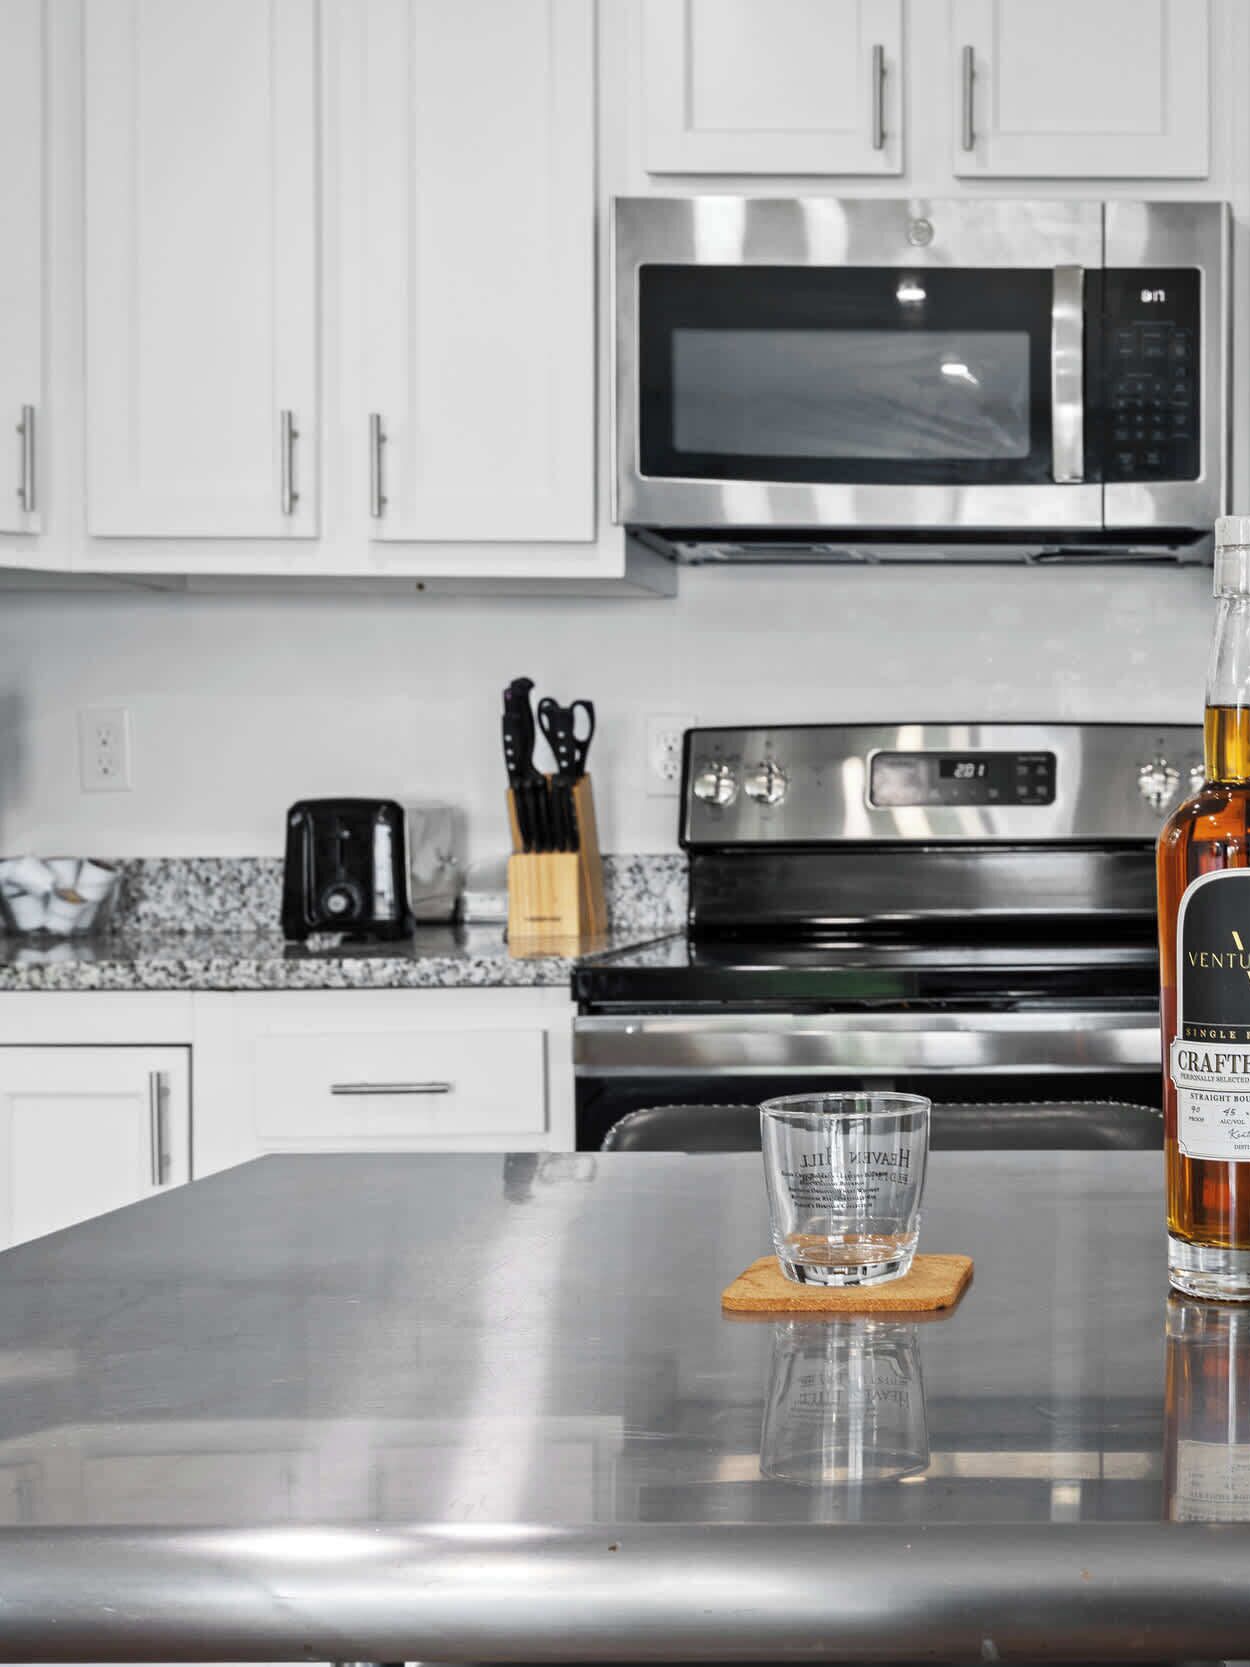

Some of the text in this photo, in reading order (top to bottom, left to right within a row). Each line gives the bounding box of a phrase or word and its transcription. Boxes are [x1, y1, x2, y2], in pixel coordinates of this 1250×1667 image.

[1185, 1027, 1237, 1040] SINGLE
[1216, 1075, 1250, 1083] SELECTED
[1190, 1092, 1231, 1102] STRAIGHT
